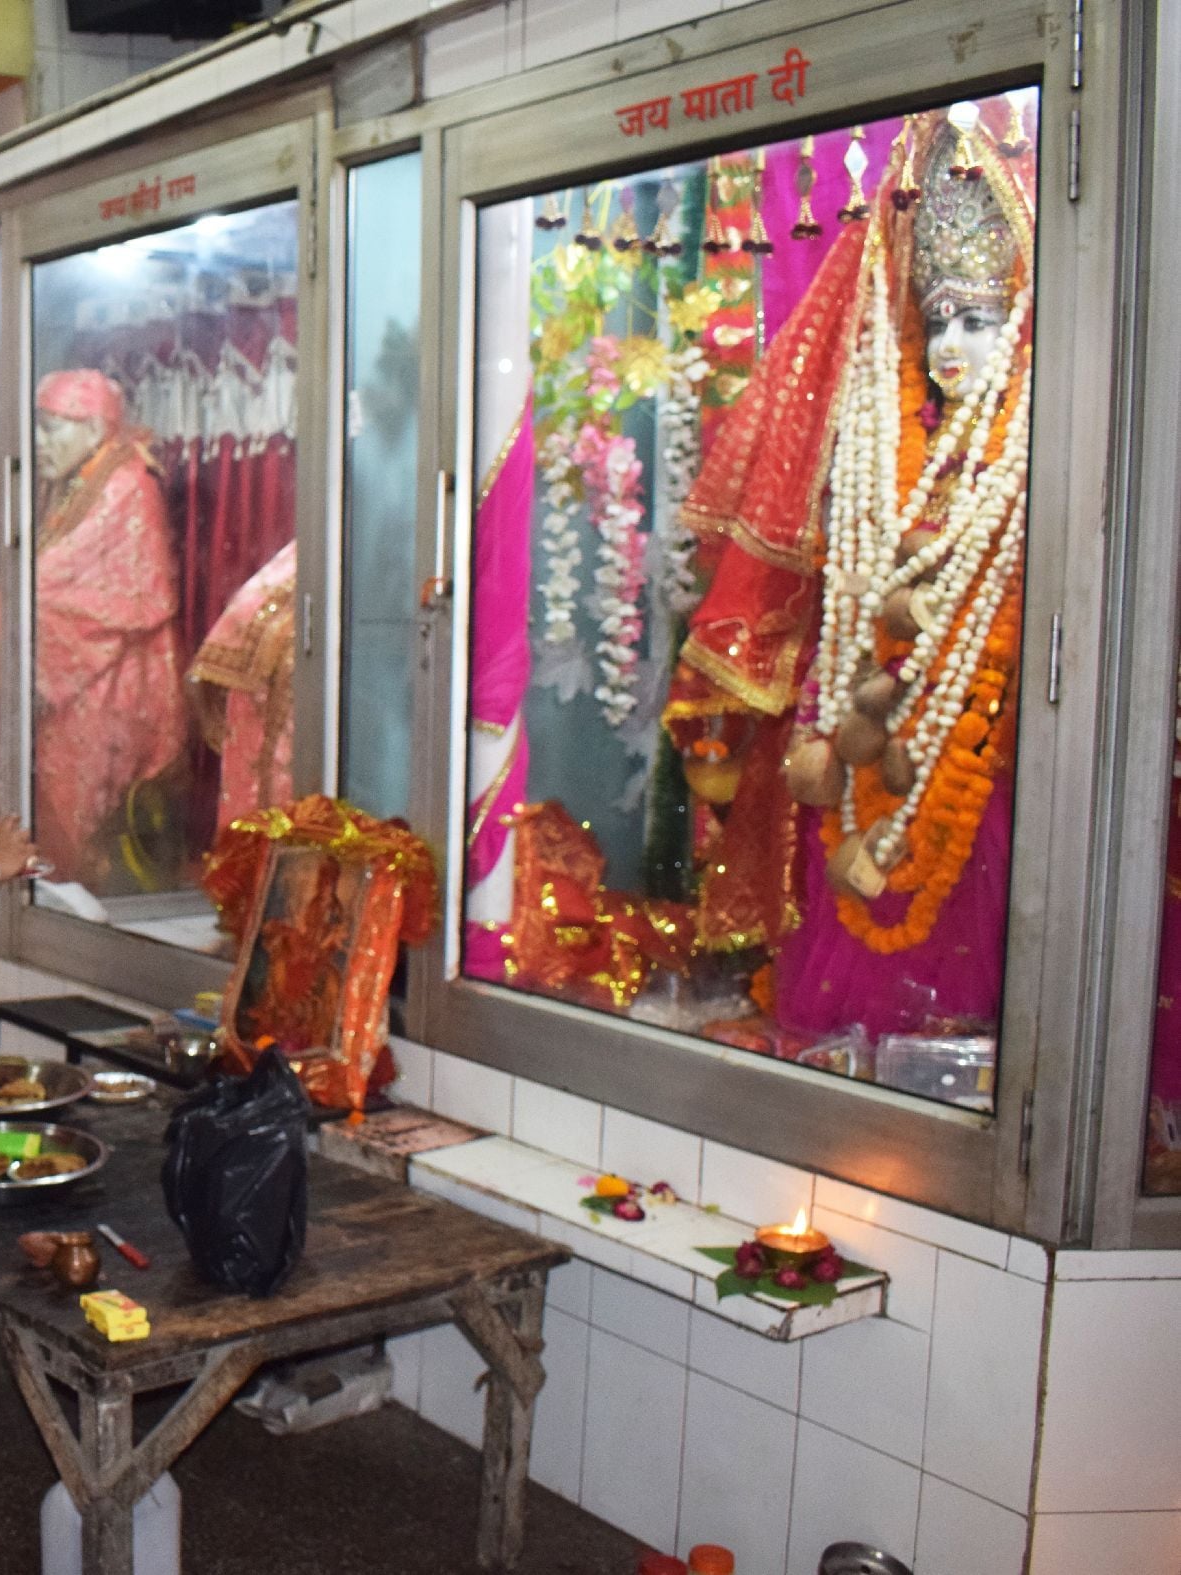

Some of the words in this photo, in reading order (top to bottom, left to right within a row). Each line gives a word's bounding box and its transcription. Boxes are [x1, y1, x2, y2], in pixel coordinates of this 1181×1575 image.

[614, 97, 672, 138] जय
[680, 74, 759, 121] माता
[767, 47, 812, 107] दी
